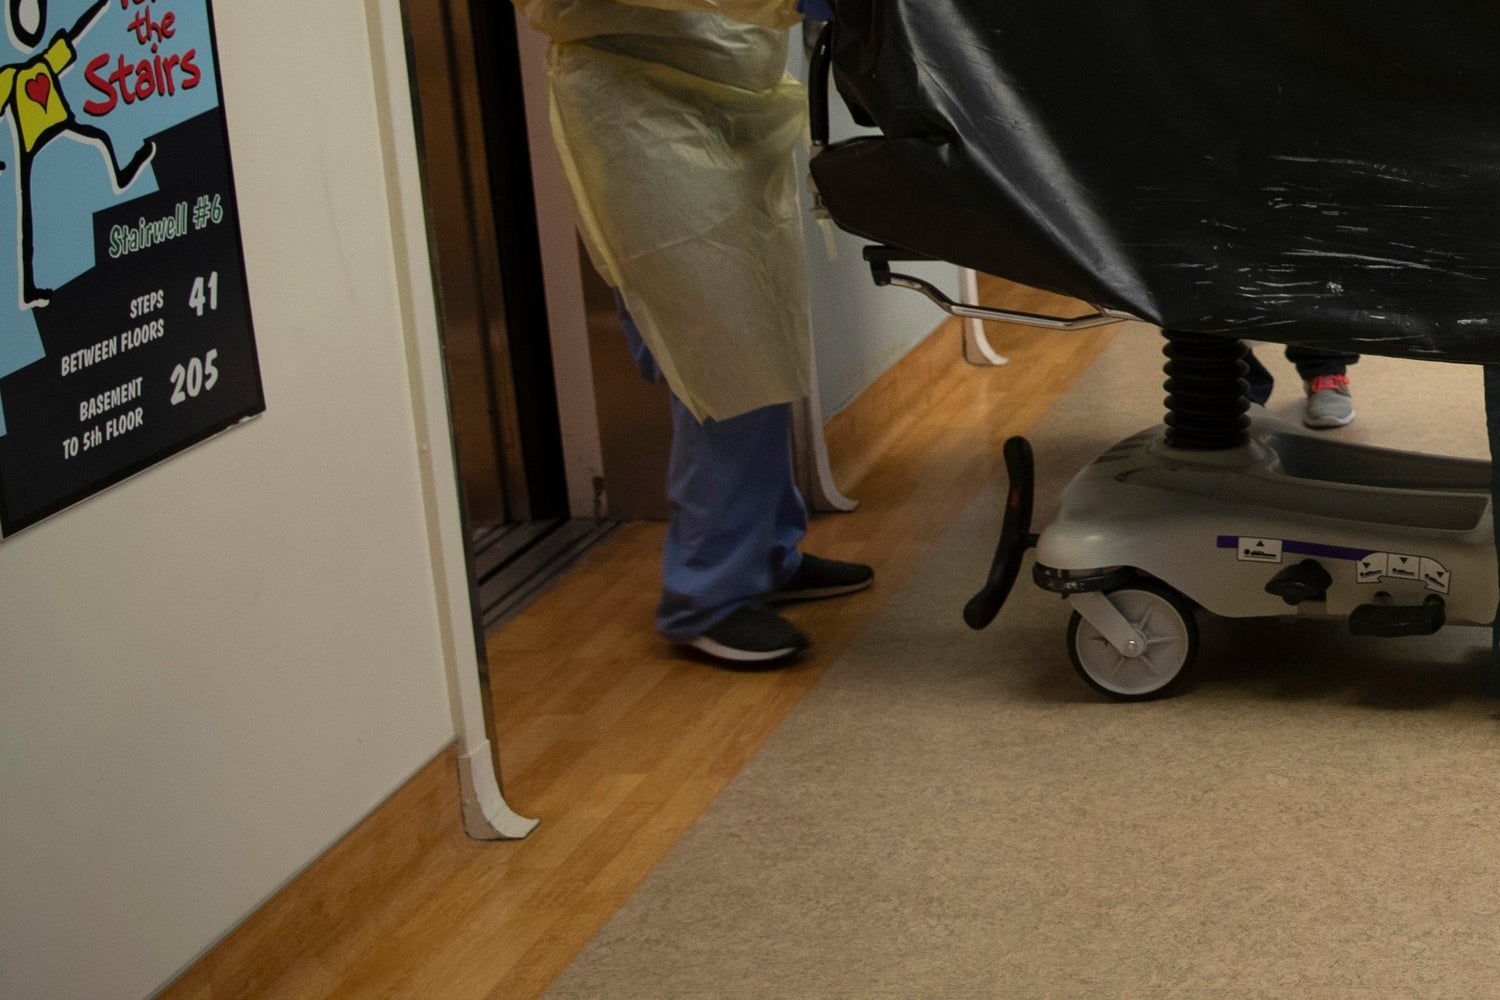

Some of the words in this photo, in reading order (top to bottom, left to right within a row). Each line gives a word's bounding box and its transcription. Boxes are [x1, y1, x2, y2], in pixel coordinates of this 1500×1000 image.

[127, 4, 176, 45] the
[83, 42, 201, 116] Stairs
[108, 200, 189, 259] Stairwell
[192, 193, 224, 230] #6
[129, 288, 165, 319] STEPS
[188, 270, 219, 317] 41
[61, 335, 117, 377] BETWEEN
[120, 317, 165, 353] FLOORS
[79, 376, 143, 422] BASEMENT
[169, 347, 219, 406] 205
[62, 435, 79, 460] TO
[82, 425, 102, 452] 5th
[105, 406, 144, 441] FLOOR
